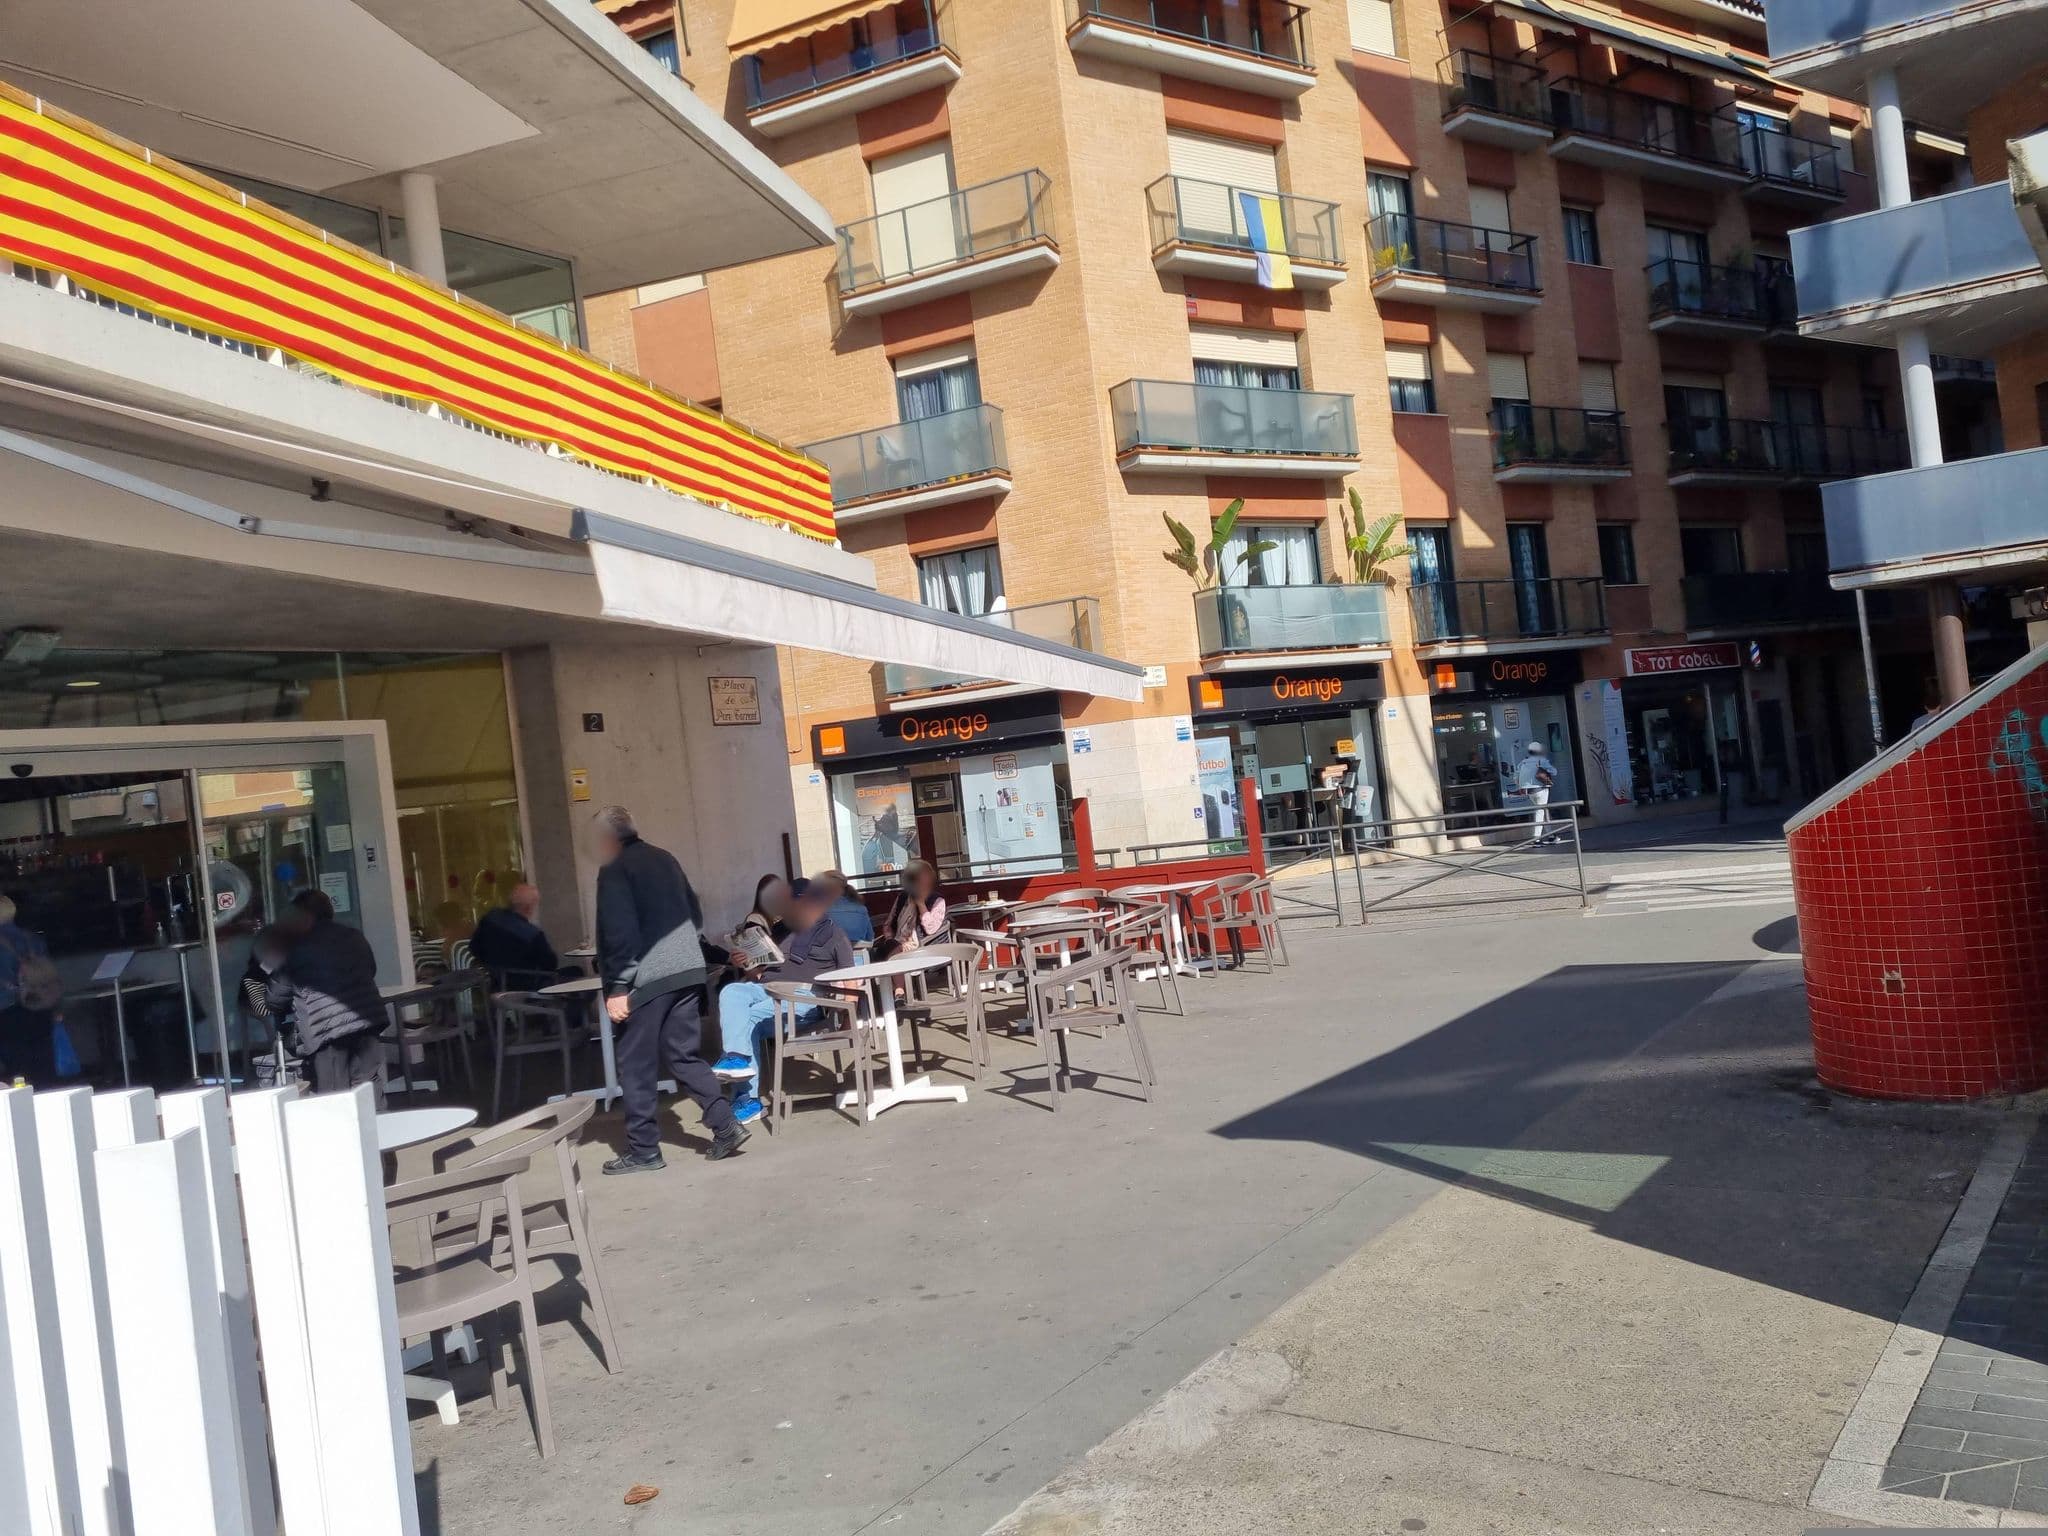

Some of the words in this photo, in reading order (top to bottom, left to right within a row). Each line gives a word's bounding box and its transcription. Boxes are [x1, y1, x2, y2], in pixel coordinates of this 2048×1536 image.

[1493, 660, 1547, 683] Orange
[1648, 656, 1673, 670] TOT
[1275, 675, 1342, 701] Orange
[591, 714, 601, 731] 2
[901, 713, 988, 741] Orange
